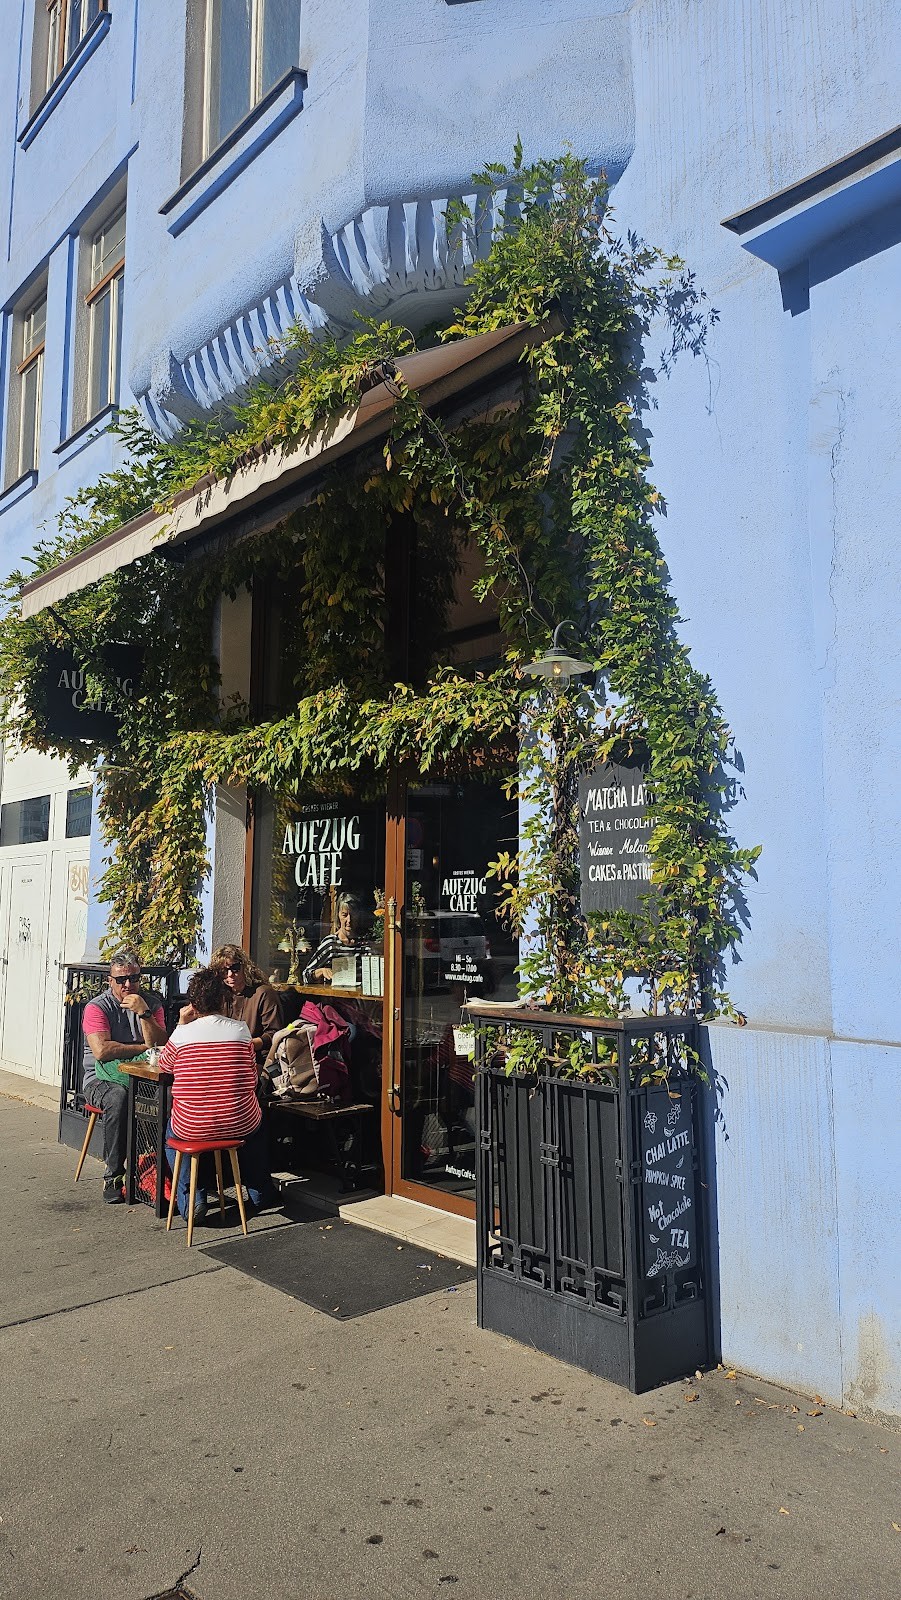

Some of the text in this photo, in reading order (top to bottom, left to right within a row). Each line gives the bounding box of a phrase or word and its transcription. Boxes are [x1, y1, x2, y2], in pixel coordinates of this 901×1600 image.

[583, 785, 628, 818] MATCHA
[281, 815, 360, 855] AUFZUG
[588, 820, 605, 833] TEA
[606, 822, 611, 831] &
[441, 877, 487, 896] AUFZUG
[645, 1130, 690, 1165] CHAI LATTE
[645, 1169, 686, 1191] PUMPKIN SPICE
[658, 1195, 692, 1231] Chocolate
[670, 1228, 690, 1250] TEA
